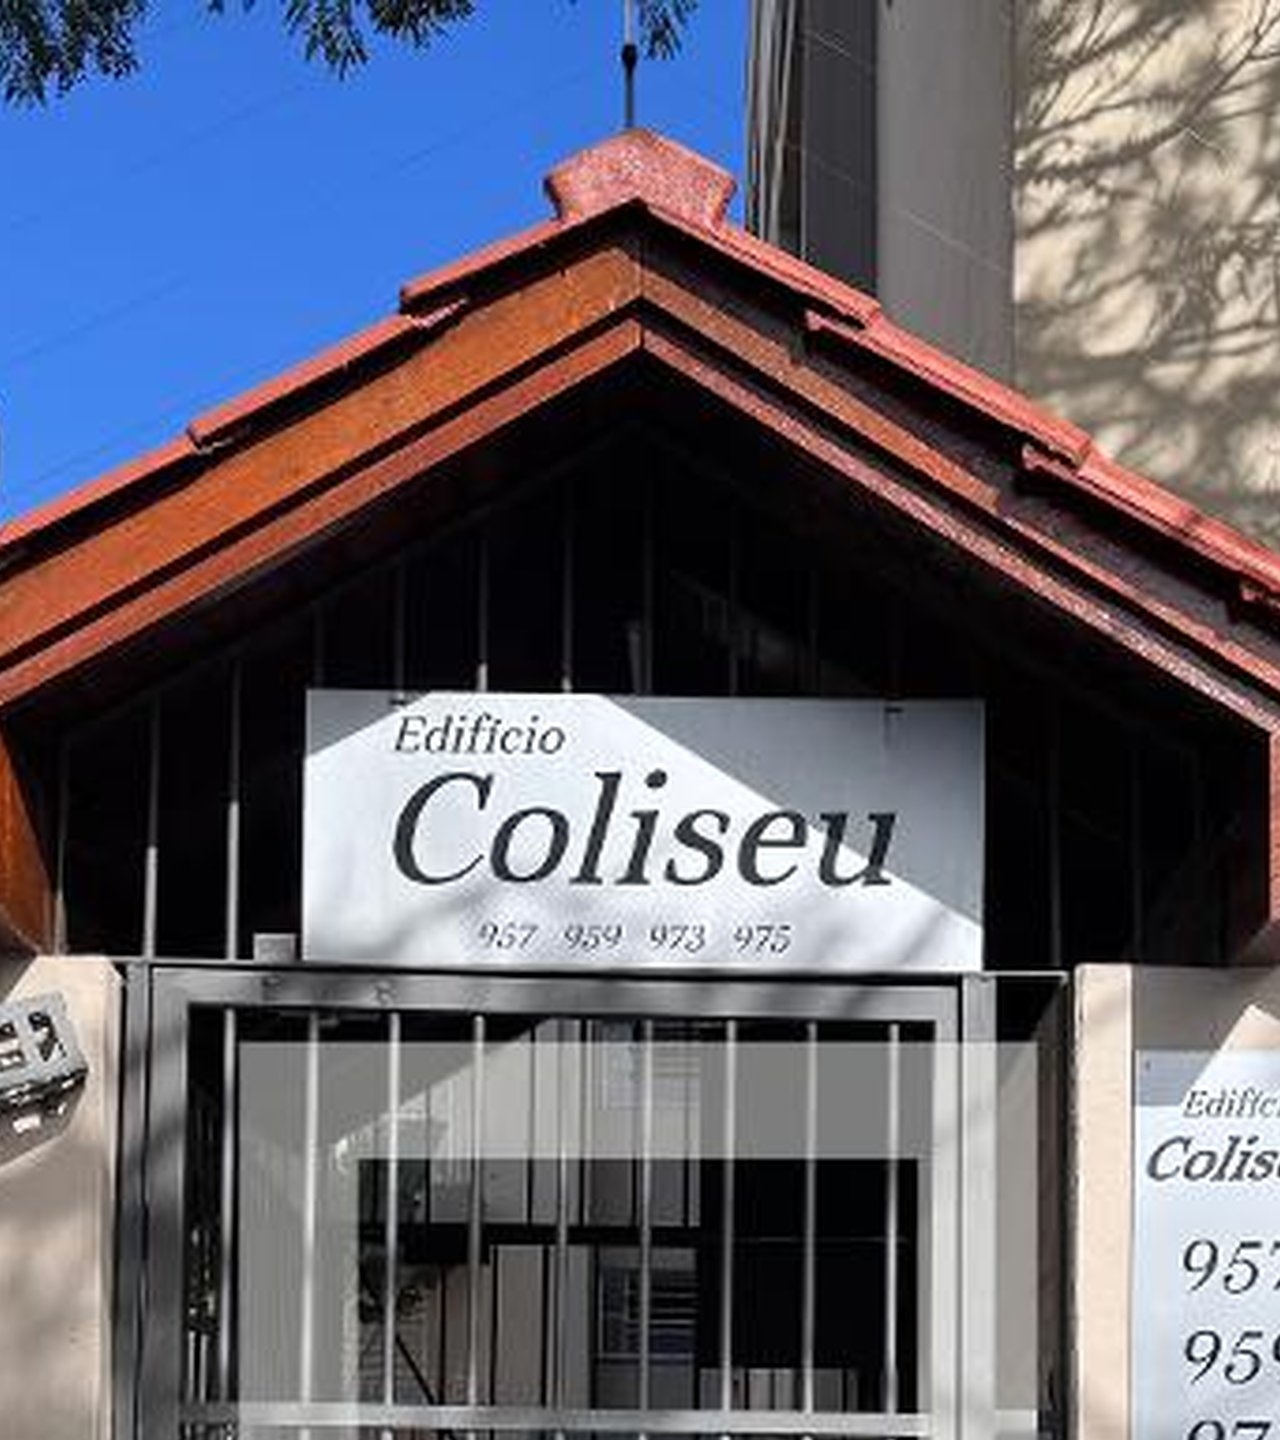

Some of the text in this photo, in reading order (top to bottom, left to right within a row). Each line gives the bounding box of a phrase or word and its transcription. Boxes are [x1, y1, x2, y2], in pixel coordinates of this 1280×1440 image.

[391, 768, 898, 887] Coliseu
[477, 921, 793, 955] 957 959 973 975
